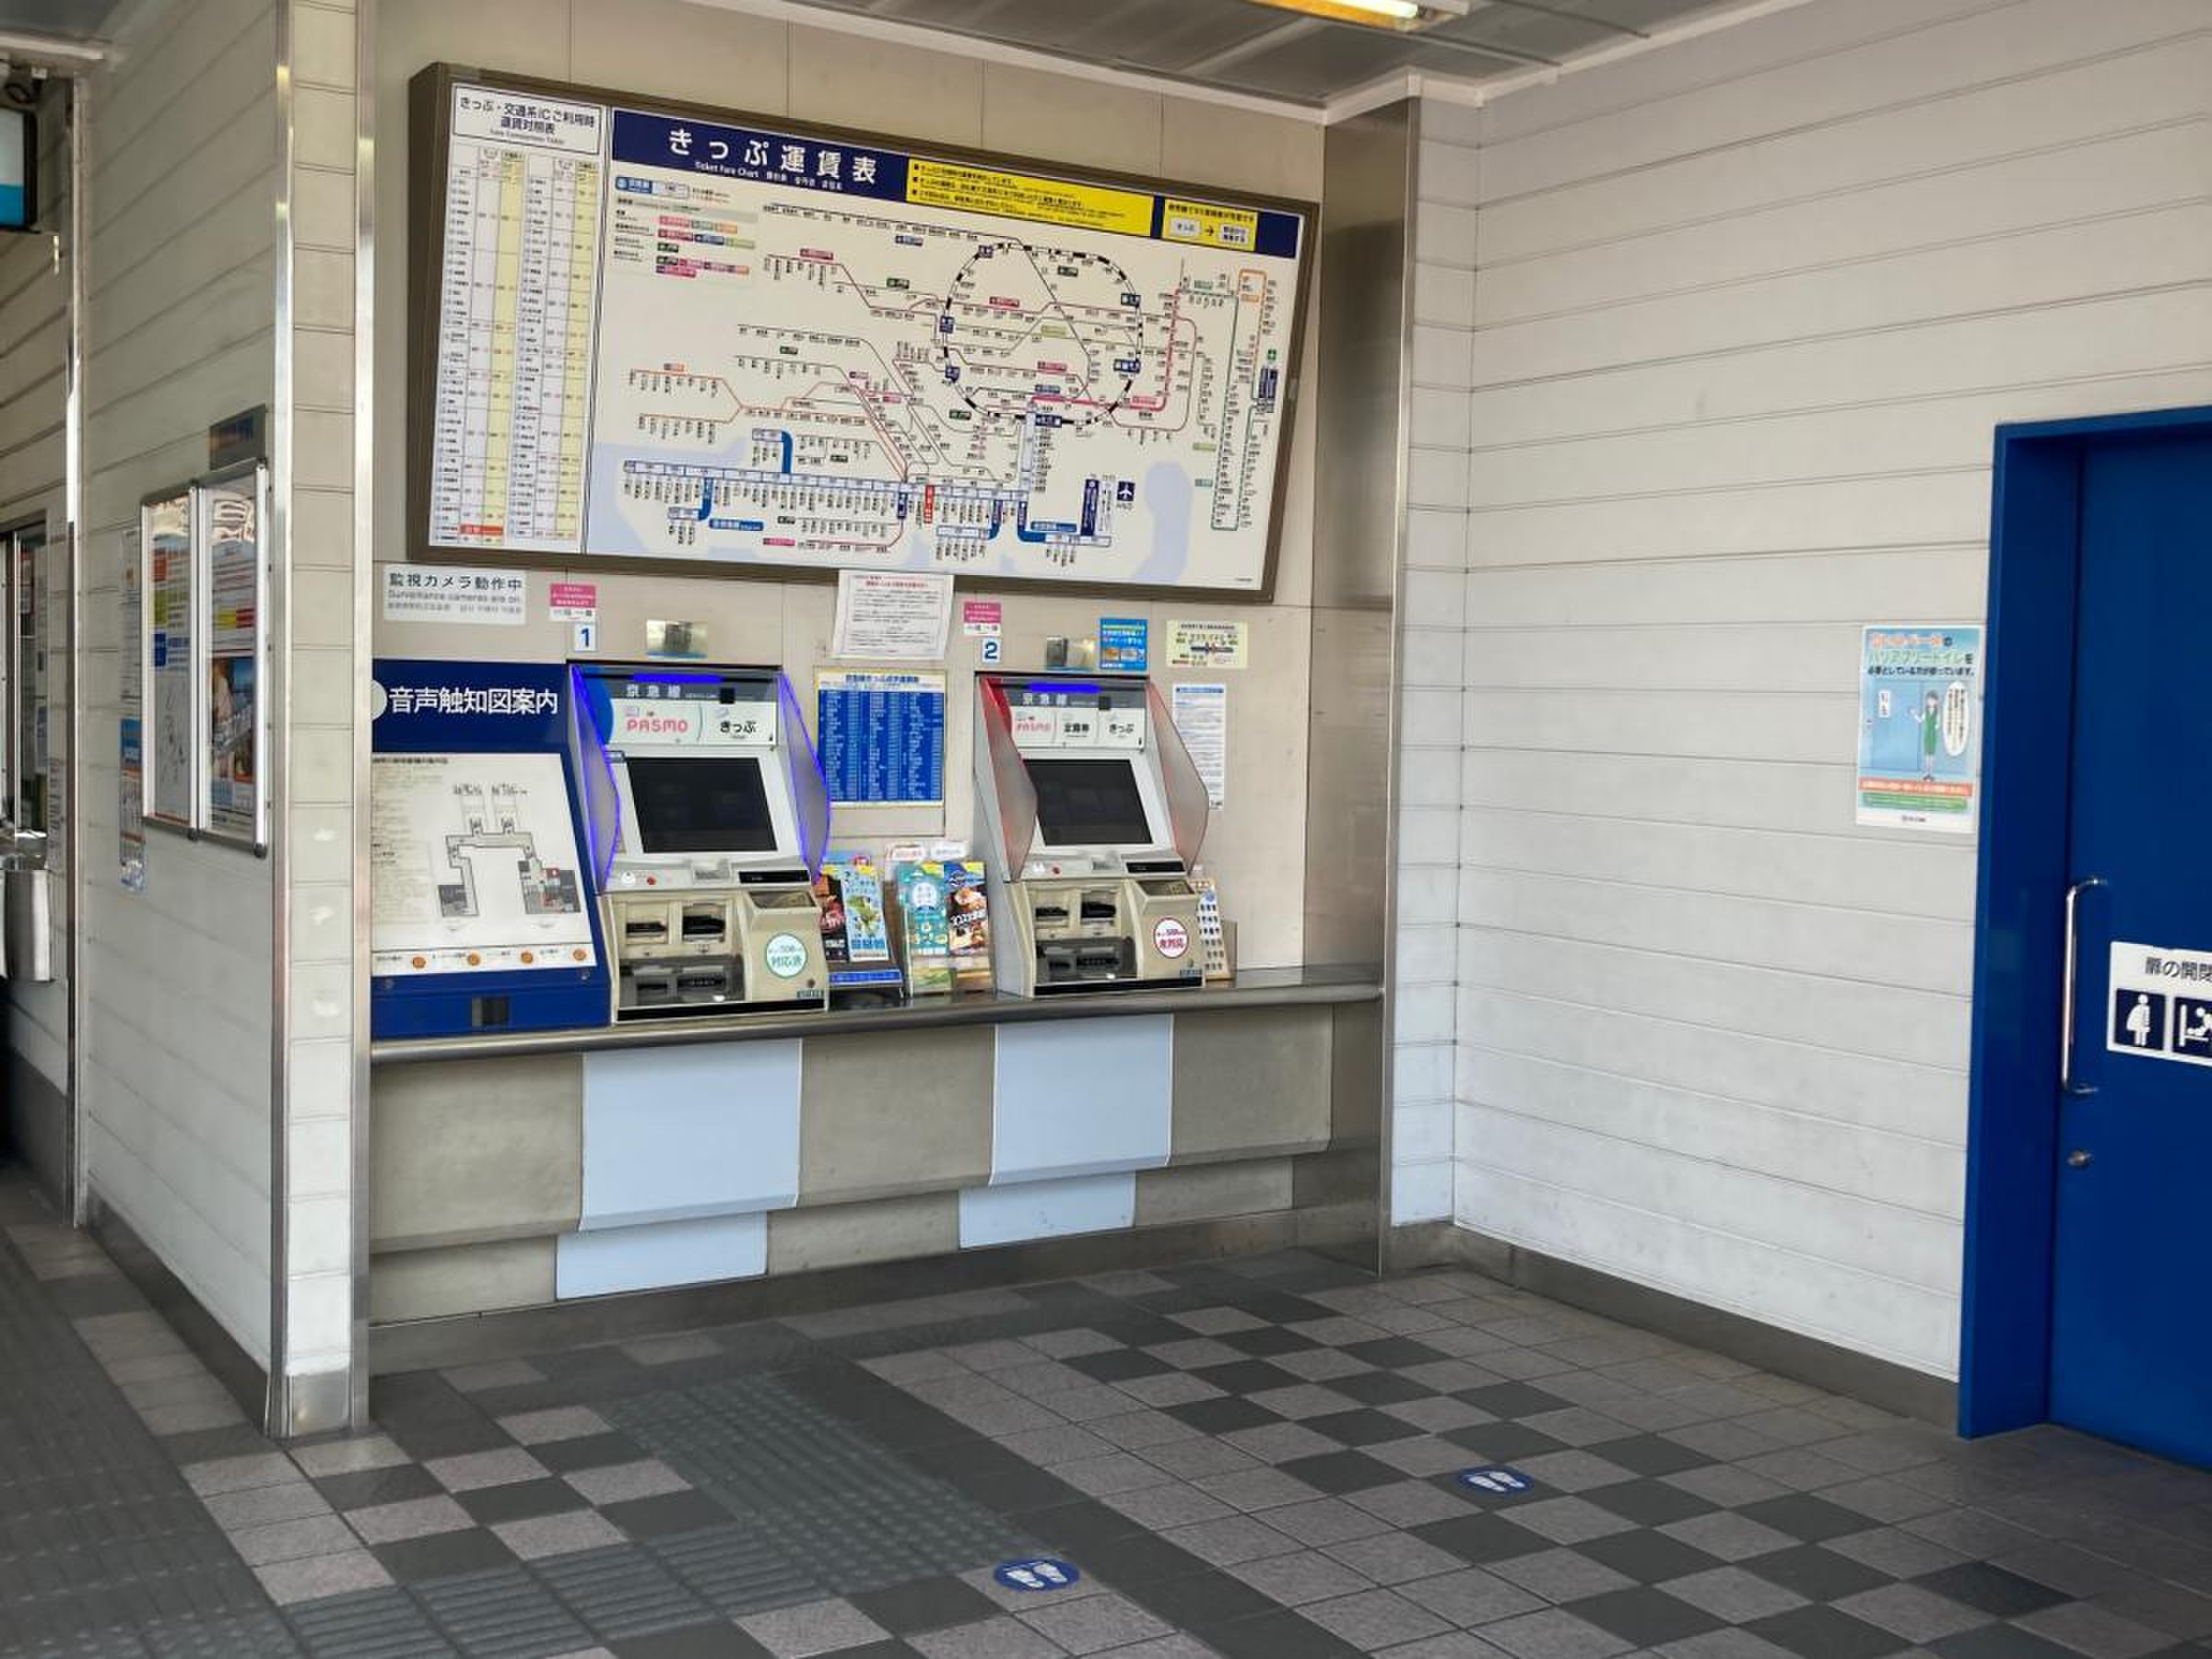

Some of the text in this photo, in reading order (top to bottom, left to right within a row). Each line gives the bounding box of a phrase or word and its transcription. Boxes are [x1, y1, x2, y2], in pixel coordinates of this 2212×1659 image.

[668, 128, 877, 184] きっぷ運賃表
[389, 572, 523, 591] 監視カメラ動作中
[581, 628, 590, 647] 1
[984, 642, 998, 660] 2
[389, 686, 559, 715] 音声触知図案内
[627, 719, 688, 734] PASMO
[720, 720, 757, 734] きっぷ
